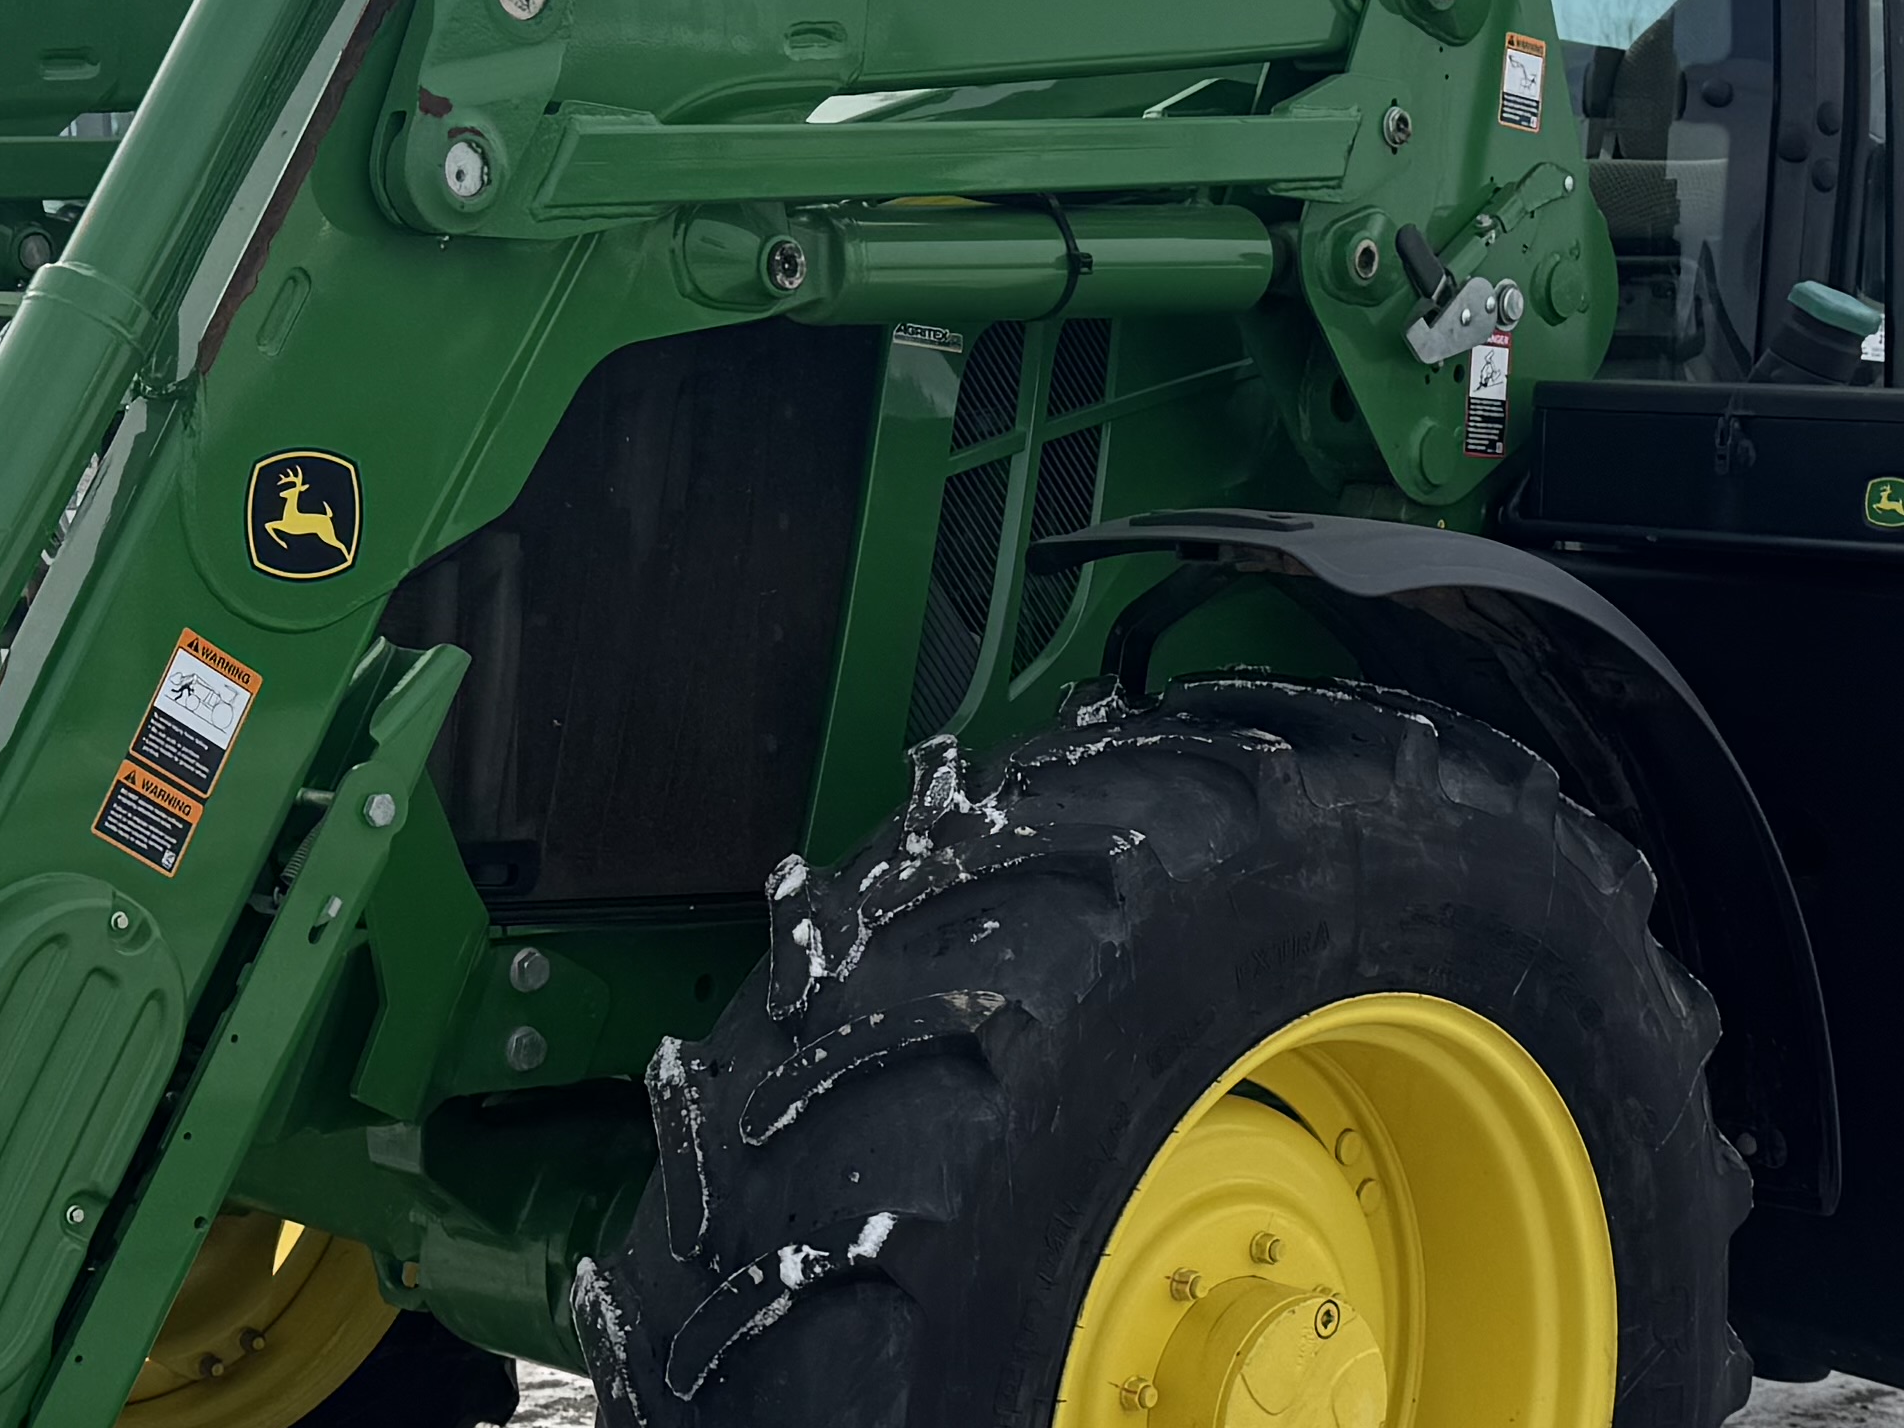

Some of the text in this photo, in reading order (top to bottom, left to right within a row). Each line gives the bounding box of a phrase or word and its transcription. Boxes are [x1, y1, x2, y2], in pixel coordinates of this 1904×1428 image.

[895, 323, 949, 341] AGRITEX
[201, 646, 251, 685] WARNING
[141, 777, 192, 817] WARNING
